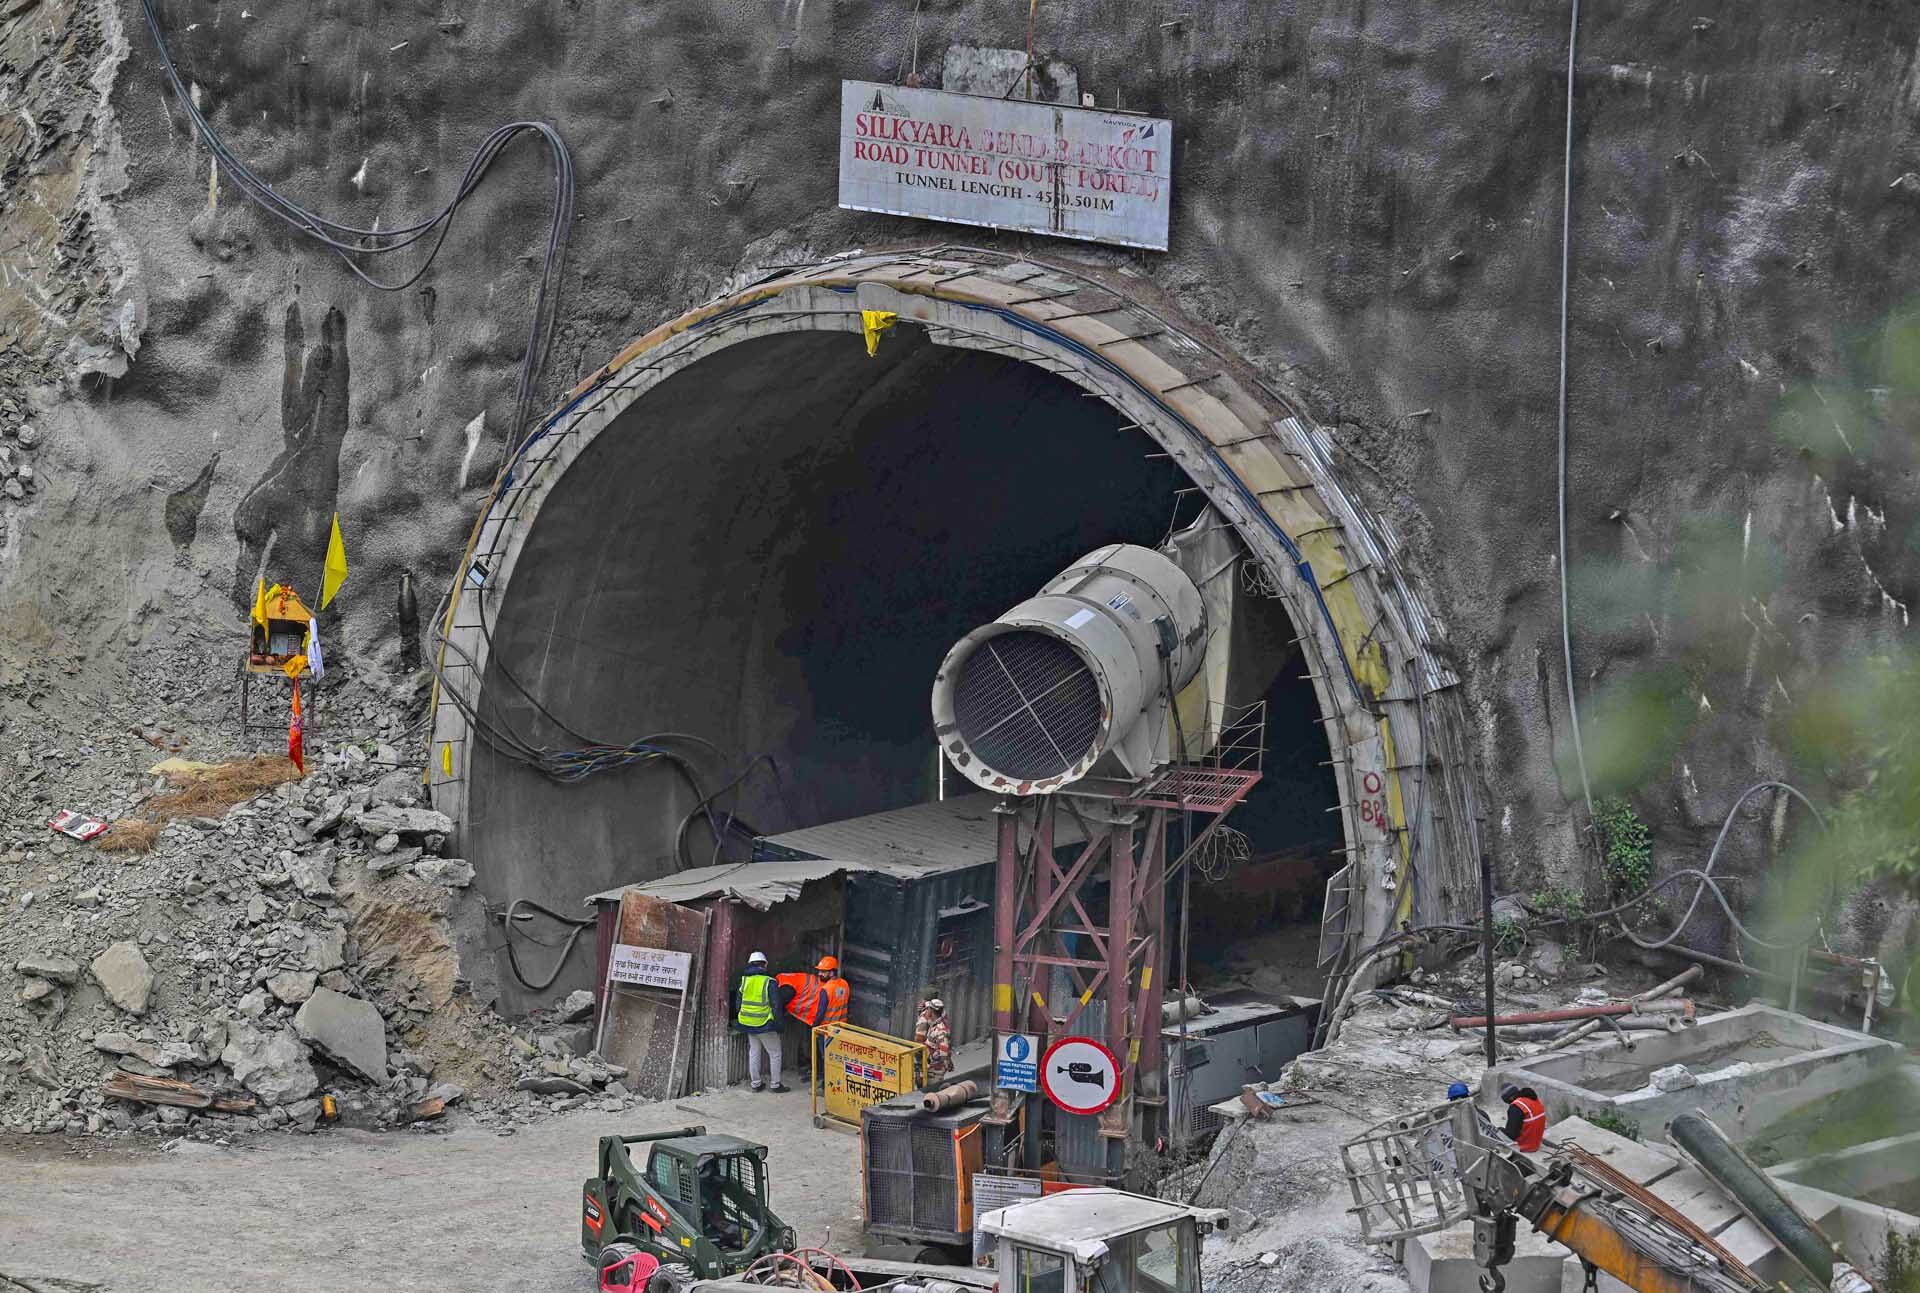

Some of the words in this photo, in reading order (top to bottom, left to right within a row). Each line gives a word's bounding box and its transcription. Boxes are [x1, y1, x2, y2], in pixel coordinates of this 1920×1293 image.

[856, 113, 972, 150] SILKYARA
[855, 141, 909, 165] ROAD
[915, 149, 989, 176] TUNNEL
[895, 171, 957, 191] TUNNEL
[961, 180, 1022, 199] LENGTH
